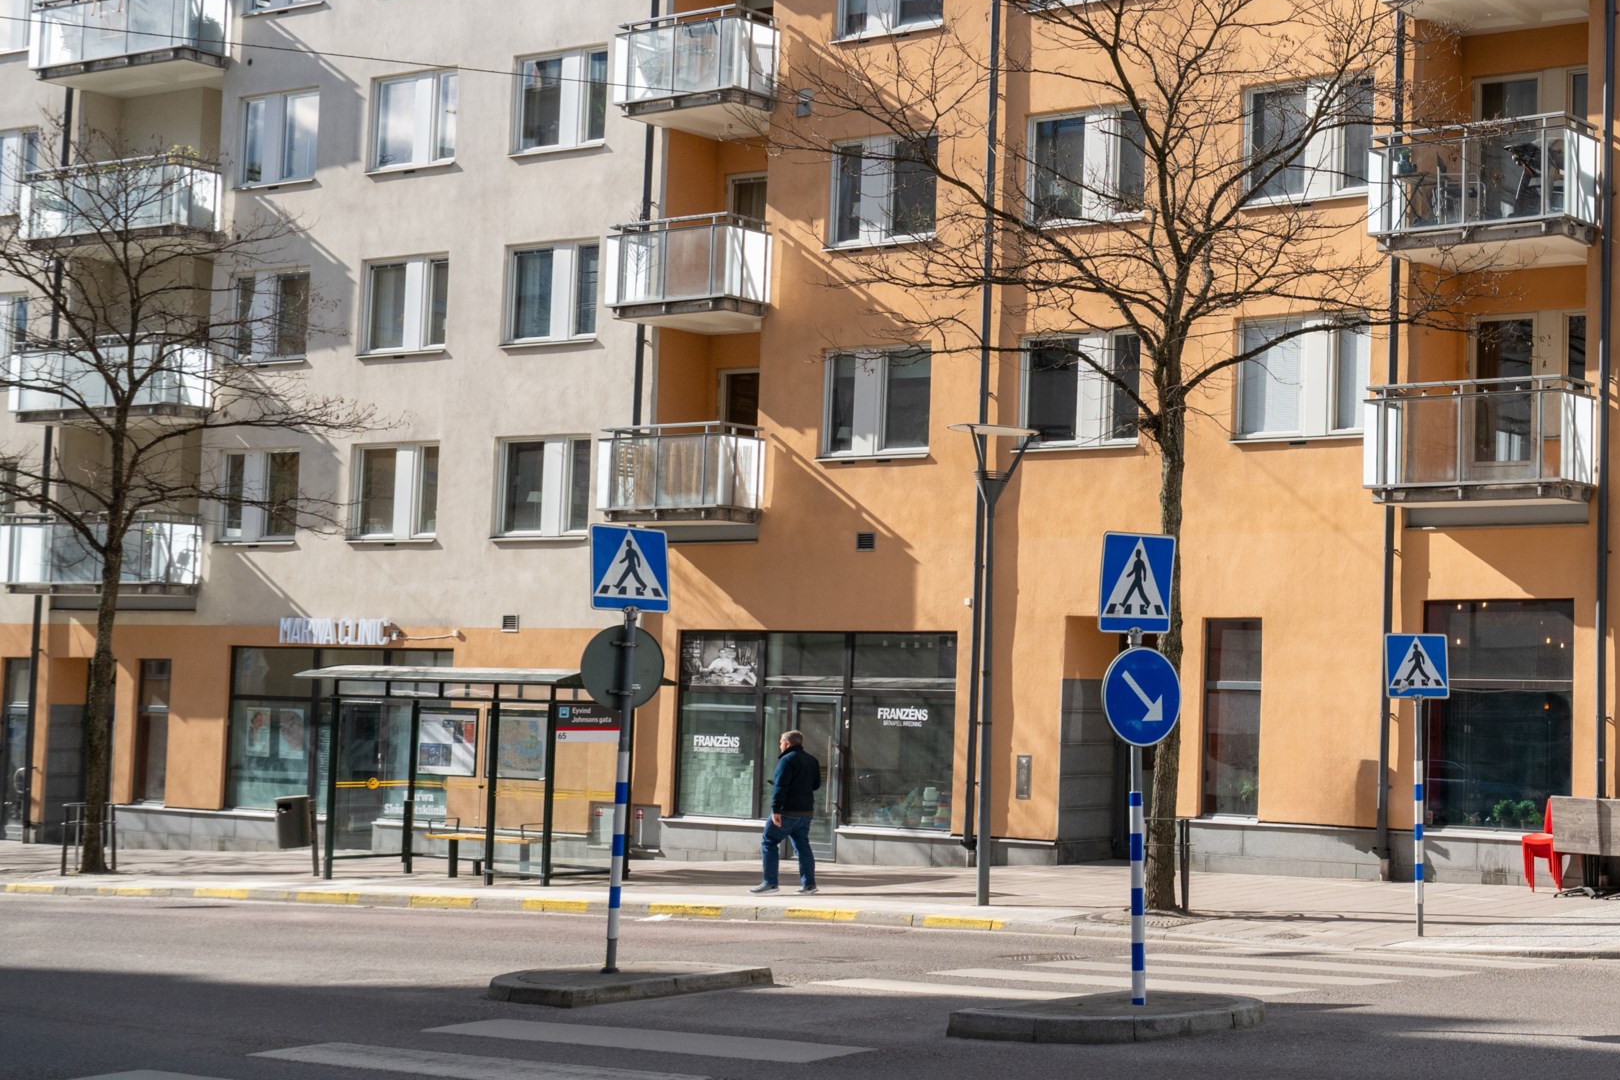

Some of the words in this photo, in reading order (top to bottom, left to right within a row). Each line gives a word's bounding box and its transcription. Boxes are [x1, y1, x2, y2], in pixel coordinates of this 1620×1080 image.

[279, 617, 336, 644] MARWA
[338, 617, 390, 645] CLINIC
[571, 707, 591, 715] Eyvind
[877, 705, 929, 721] FRANZÉNS
[558, 732, 567, 740] 65
[693, 733, 740, 748] FRANZÉNS
